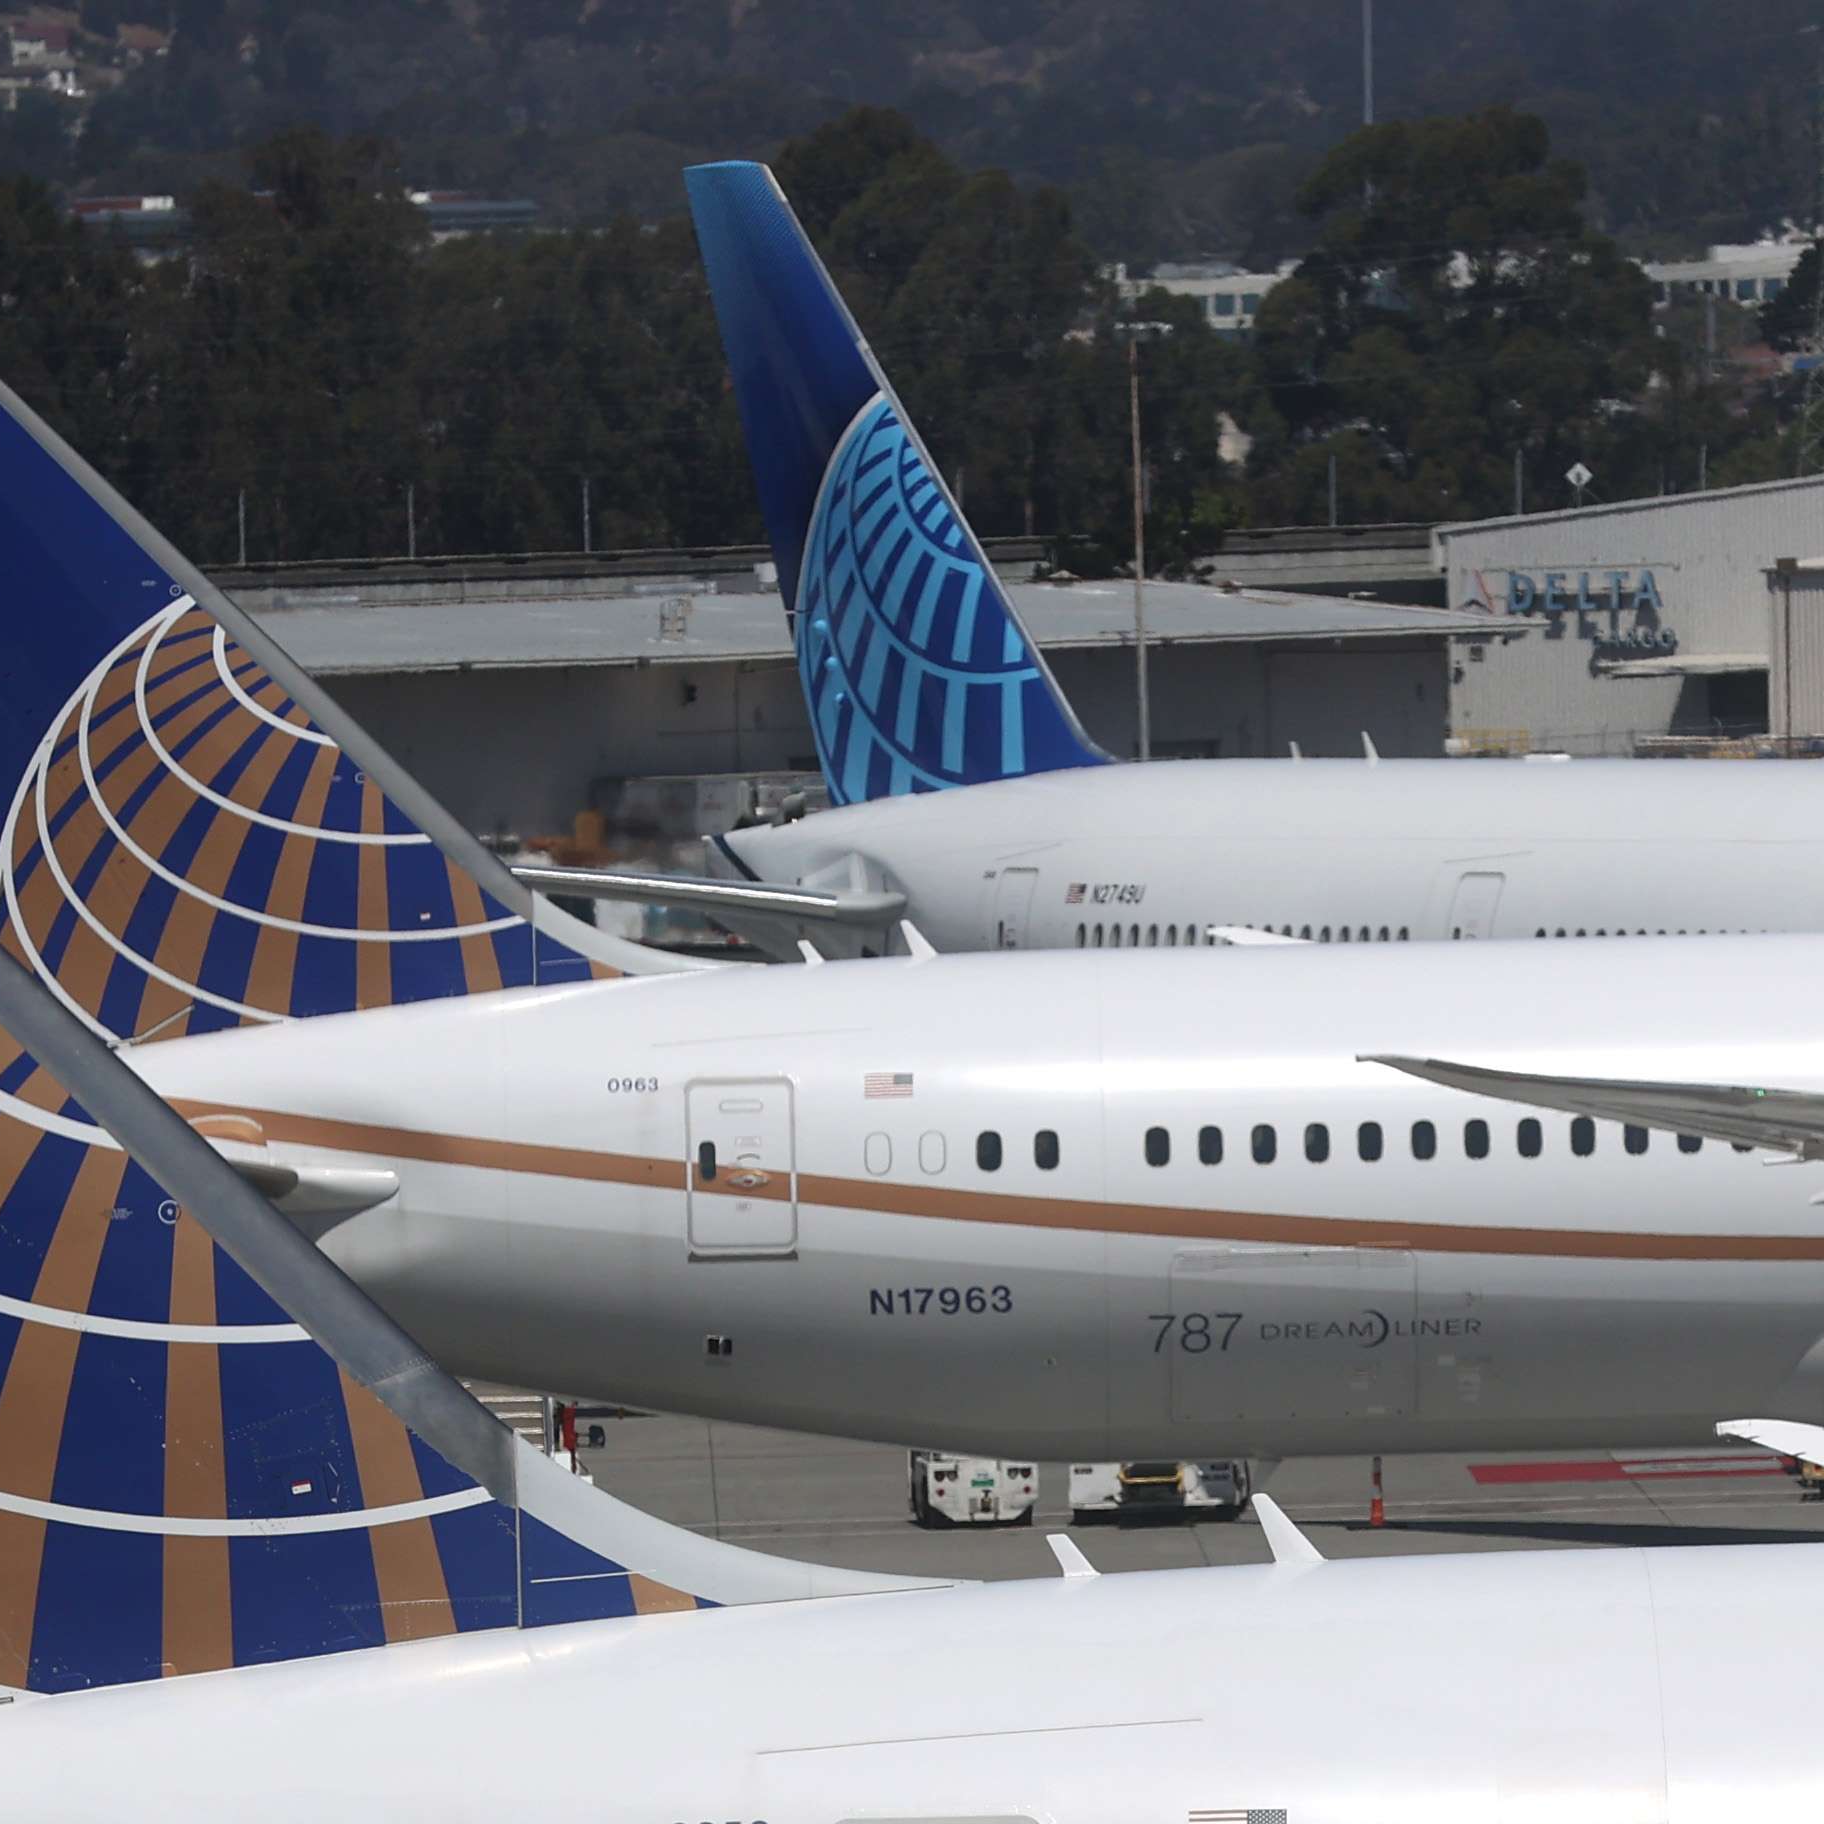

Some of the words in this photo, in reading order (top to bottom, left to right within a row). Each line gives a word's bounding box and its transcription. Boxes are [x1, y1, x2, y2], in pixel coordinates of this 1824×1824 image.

[1507, 569, 1664, 615] DELTA
[607, 1077, 659, 1093] 0963
[869, 1285, 1014, 1315] N17963
[1148, 1313, 1244, 1353] 787
